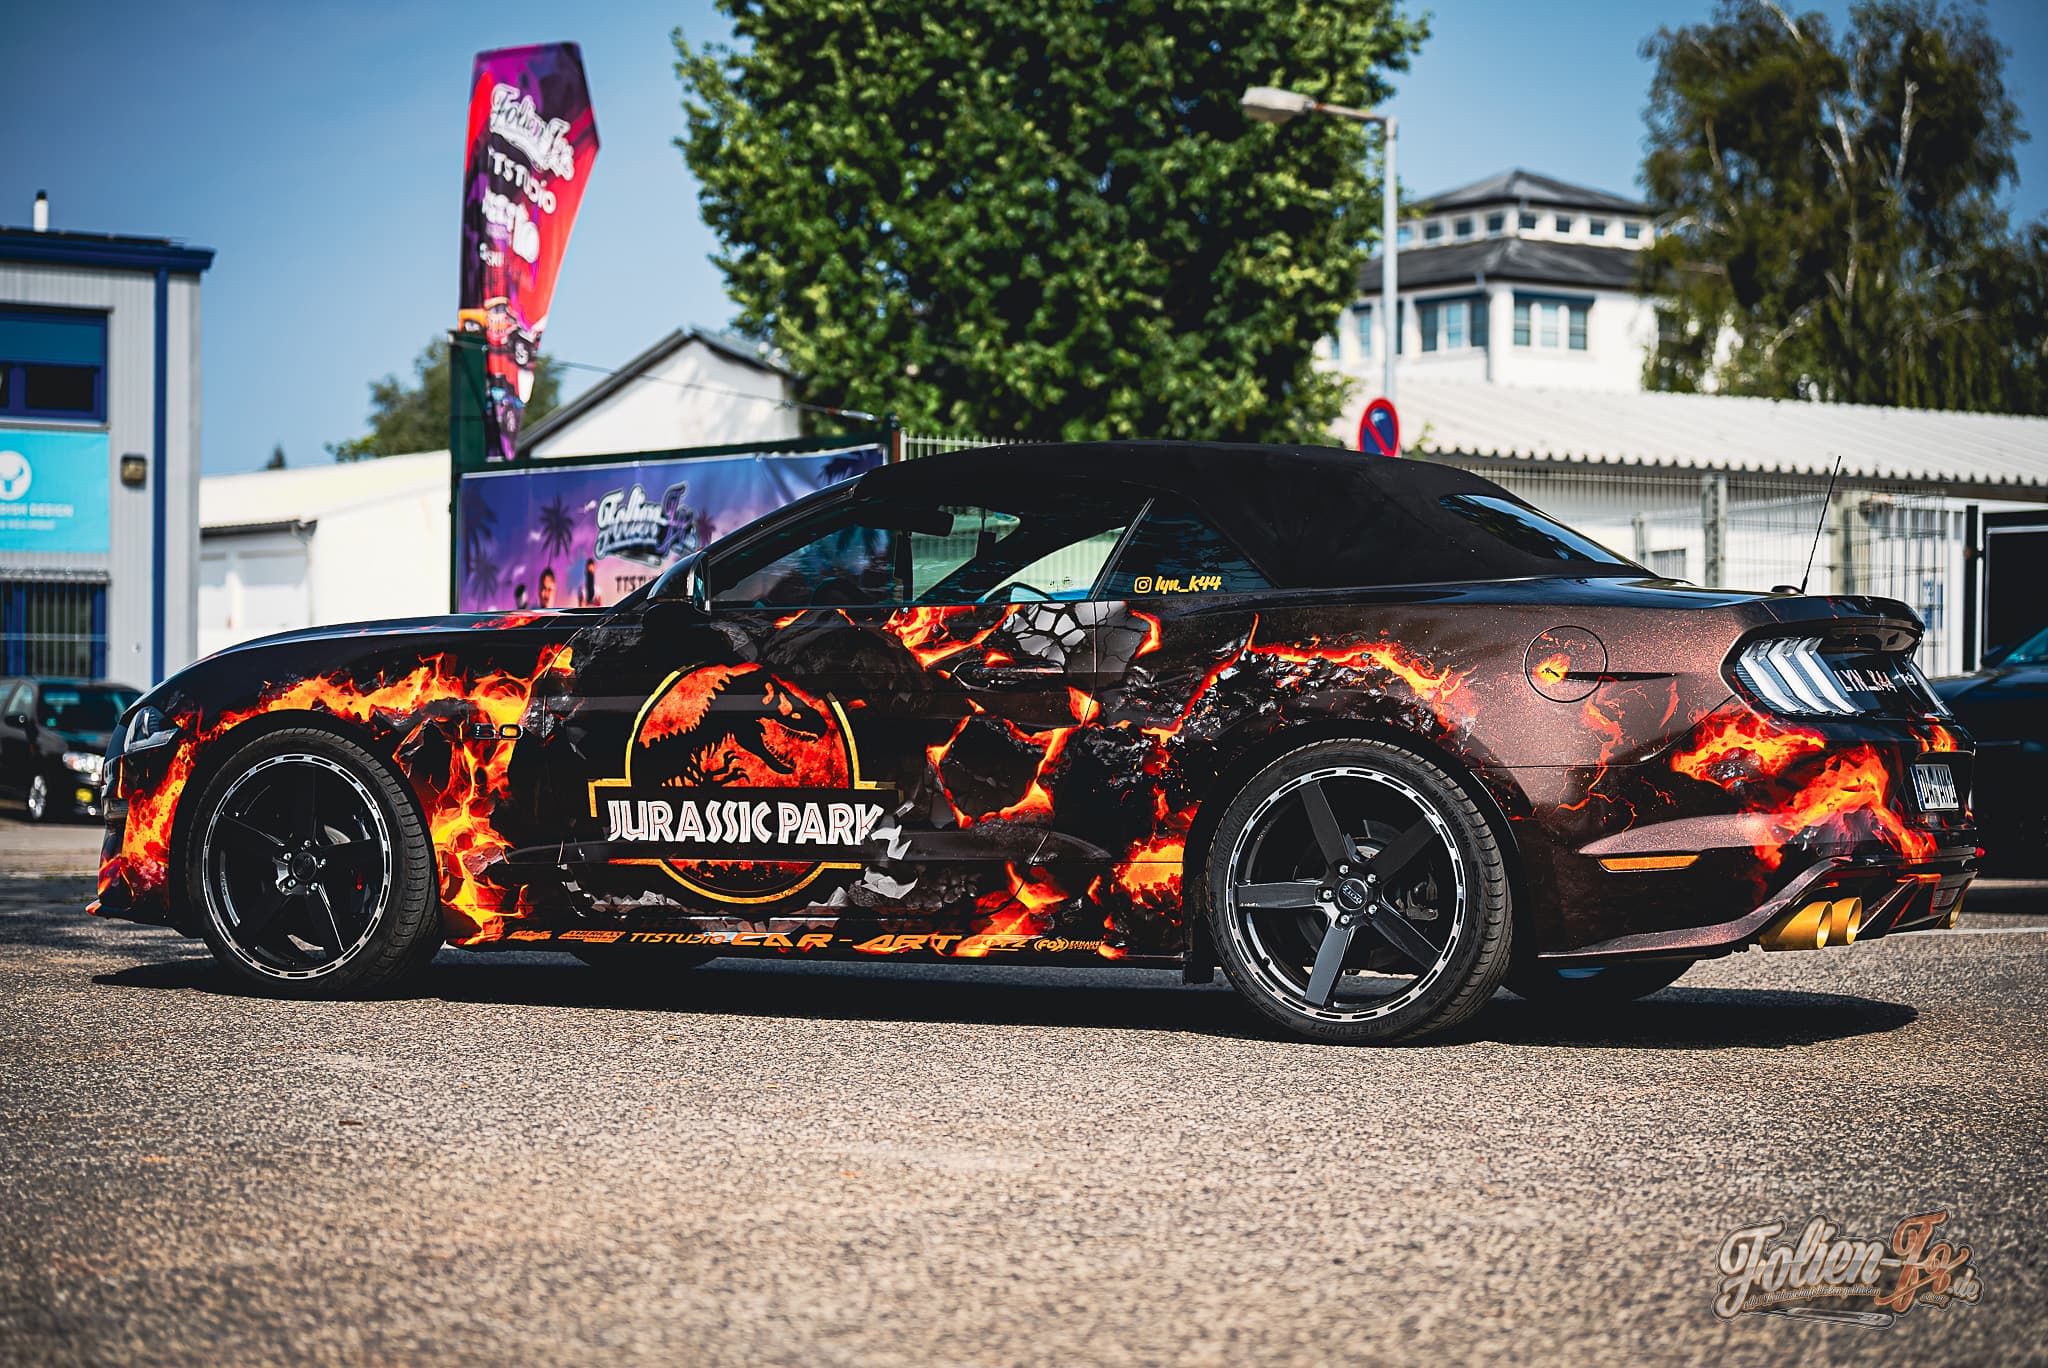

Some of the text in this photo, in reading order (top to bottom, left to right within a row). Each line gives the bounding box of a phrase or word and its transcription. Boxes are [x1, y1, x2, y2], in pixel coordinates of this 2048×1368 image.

[474, 723, 523, 739] 5.0
[607, 800, 885, 846] JURASSIC PARK
[730, 933, 833, 948] CAR
